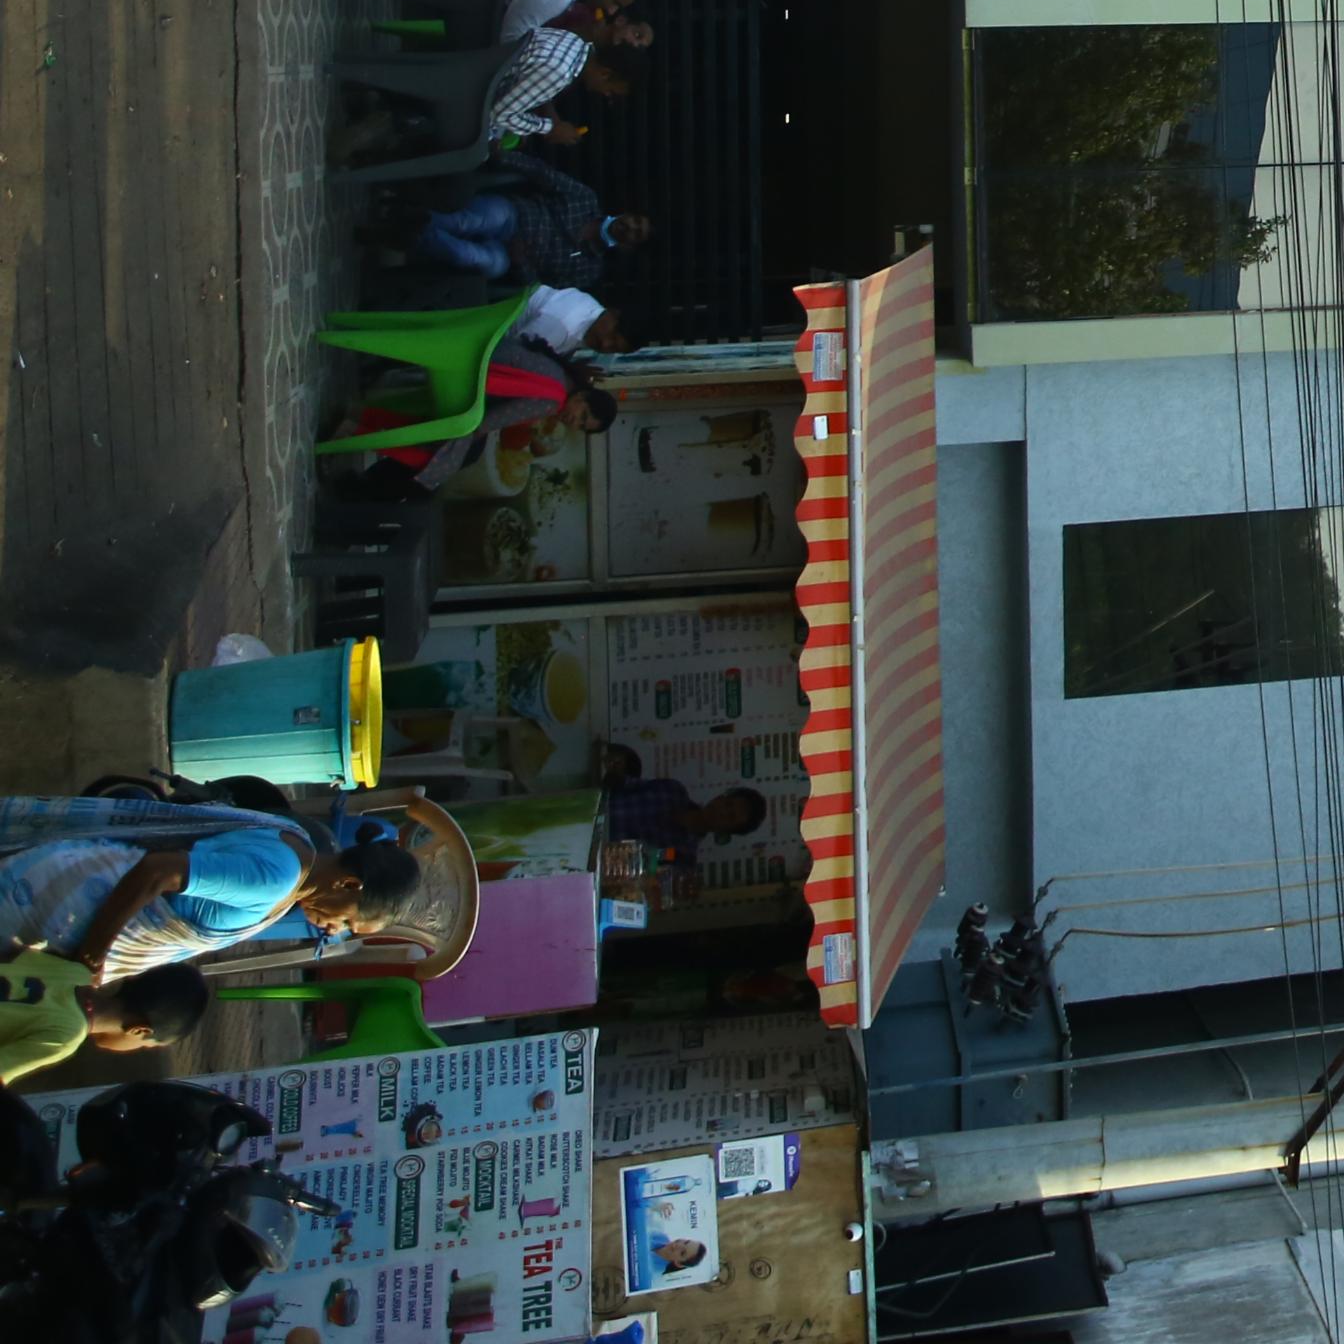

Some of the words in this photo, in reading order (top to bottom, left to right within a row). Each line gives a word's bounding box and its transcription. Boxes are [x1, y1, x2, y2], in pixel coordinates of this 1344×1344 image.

[352, 1065, 360, 1088] PEPPER
[568, 1054, 582, 1092] TEA
[283, 1088, 299, 1106] COLD
[380, 1078, 395, 1119] MILK
[380, 1160, 388, 1174] TEA
[500, 1141, 508, 1171] COOKIES
[562, 1132, 570, 1184] BUTTERSCOTCH
[339, 1166, 348, 1201] PINKLADY
[366, 1162, 374, 1186] VIRGIN
[379, 1176, 387, 1194] TREE
[449, 1162, 457, 1187] MOJITO
[462, 1166, 470, 1191] MOJITO
[478, 1160, 492, 1207] MOCKTAIL
[401, 1180, 416, 1210] SPECIAL
[512, 1168, 520, 1206] MILKSHAKE
[562, 1186, 570, 1208] SHAKE
[378, 1196, 386, 1226] MEMORY
[689, 1200, 698, 1229] KEMIN
[399, 1210, 415, 1248] MOCKTAIL
[409, 1266, 418, 1278] DRY
[424, 1264, 433, 1280] STAR
[523, 1240, 553, 1279] TEA
[378, 1271, 387, 1292] HONEY
[394, 1269, 402, 1290] BLACK
[408, 1280, 417, 1298] FRUIT
[392, 1292, 401, 1322] CURRANT
[408, 1300, 417, 1322] SHAKE
[423, 1308, 432, 1329] SHAKE
[522, 1280, 552, 1332] TREE
